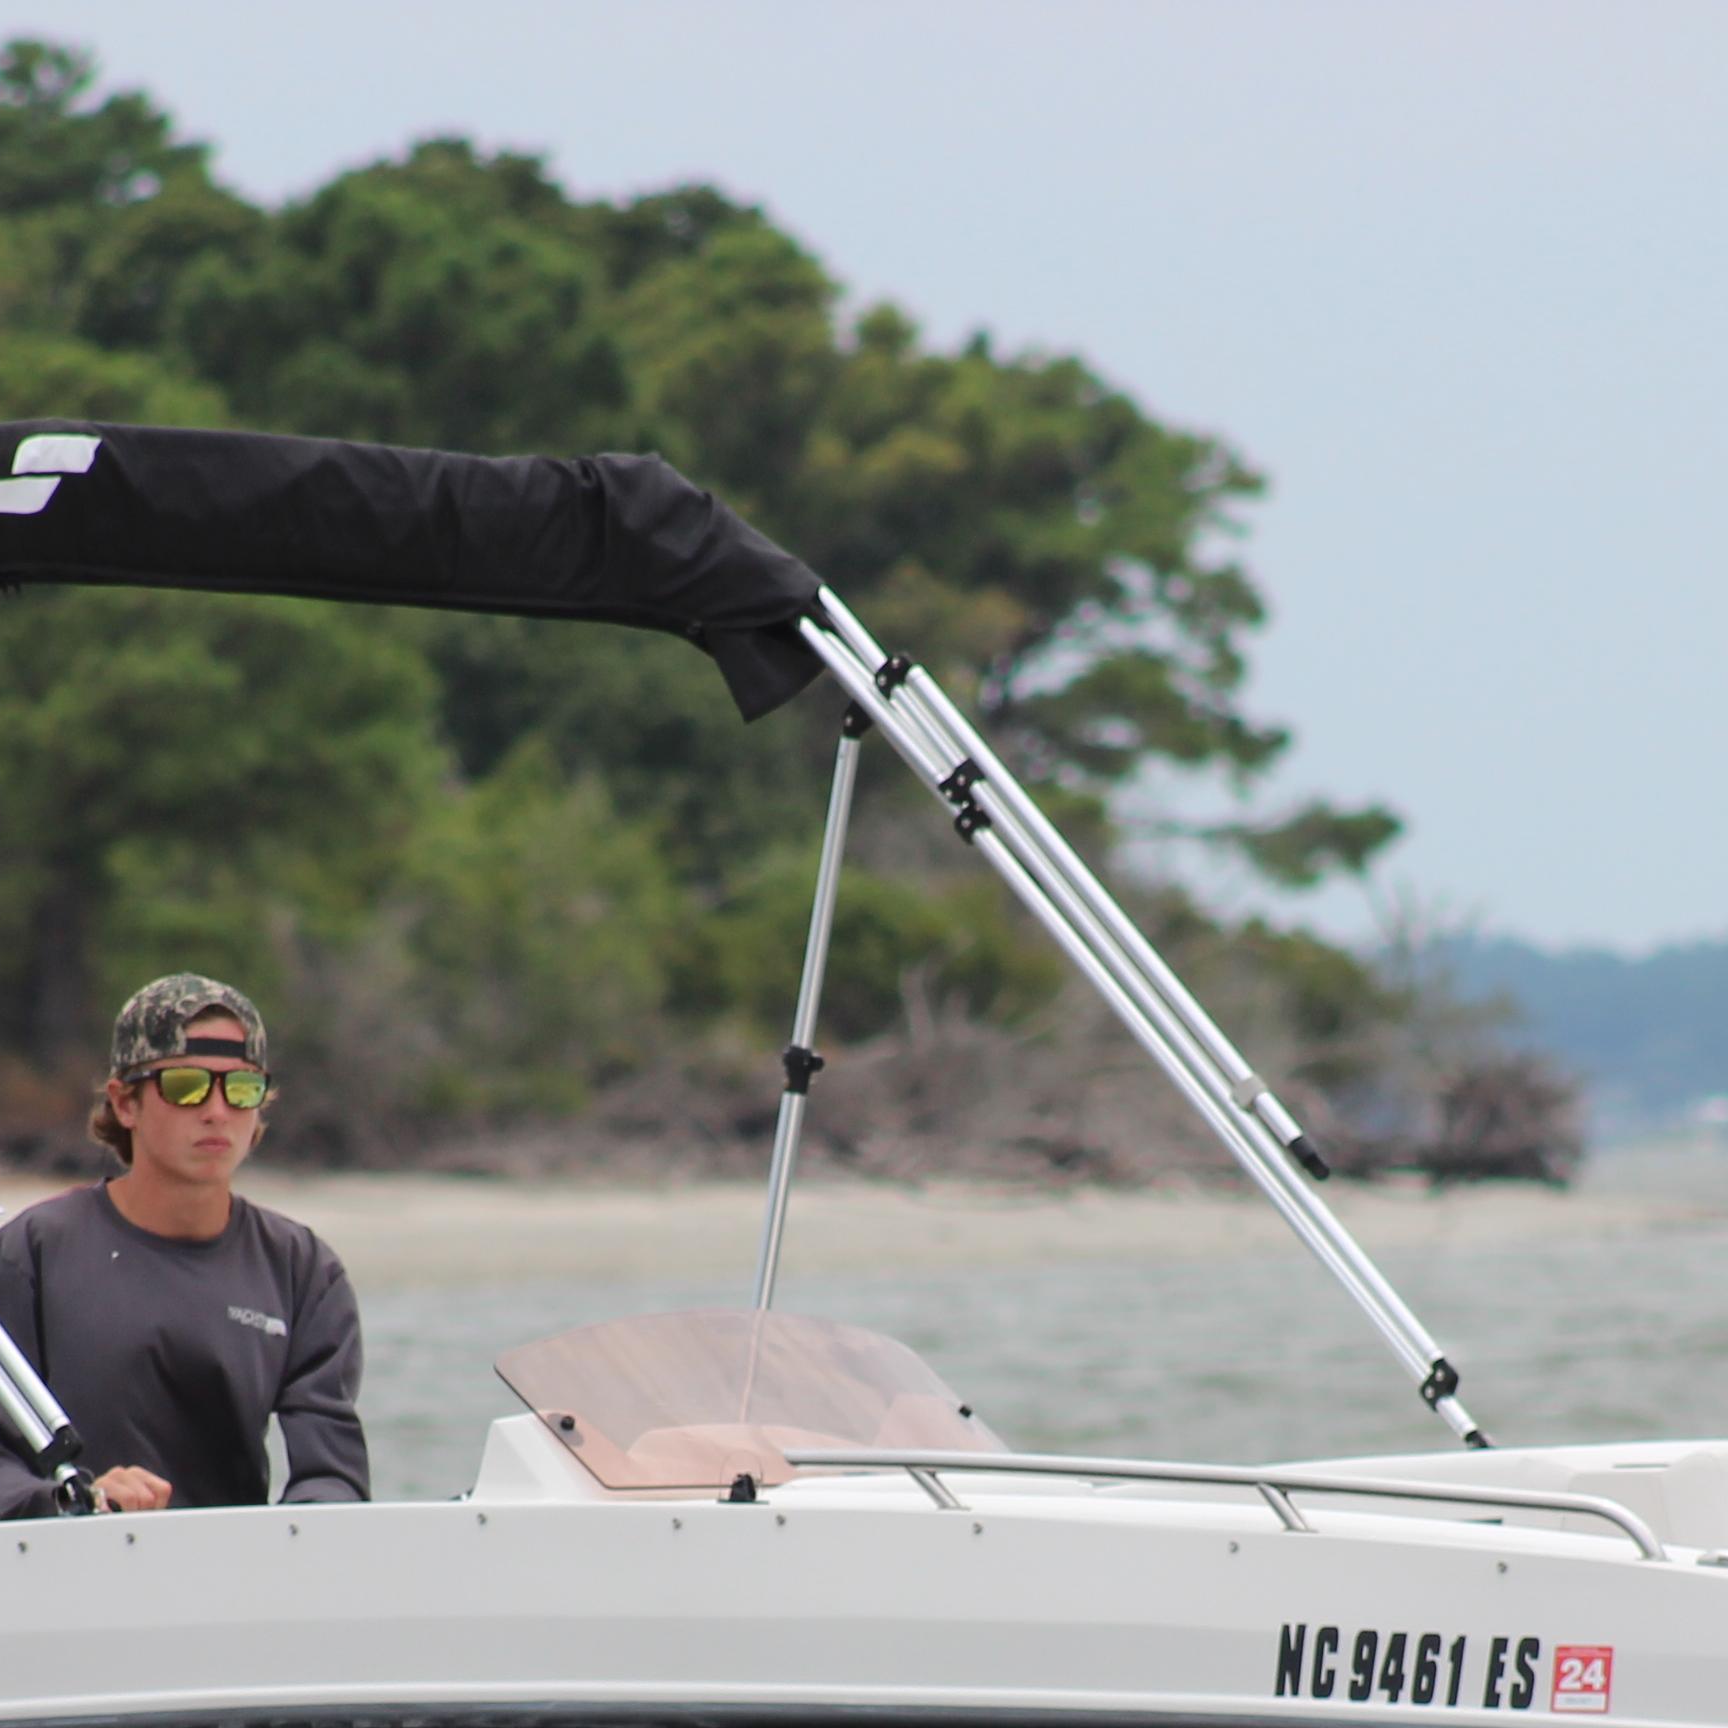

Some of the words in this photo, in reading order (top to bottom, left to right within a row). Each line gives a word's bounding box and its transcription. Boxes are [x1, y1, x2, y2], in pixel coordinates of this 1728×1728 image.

[1275, 1624, 1339, 1700] NC
[1348, 1630, 1466, 1706] 9461
[1483, 1637, 1541, 1710] ES
[1558, 1657, 1606, 1691] 24
